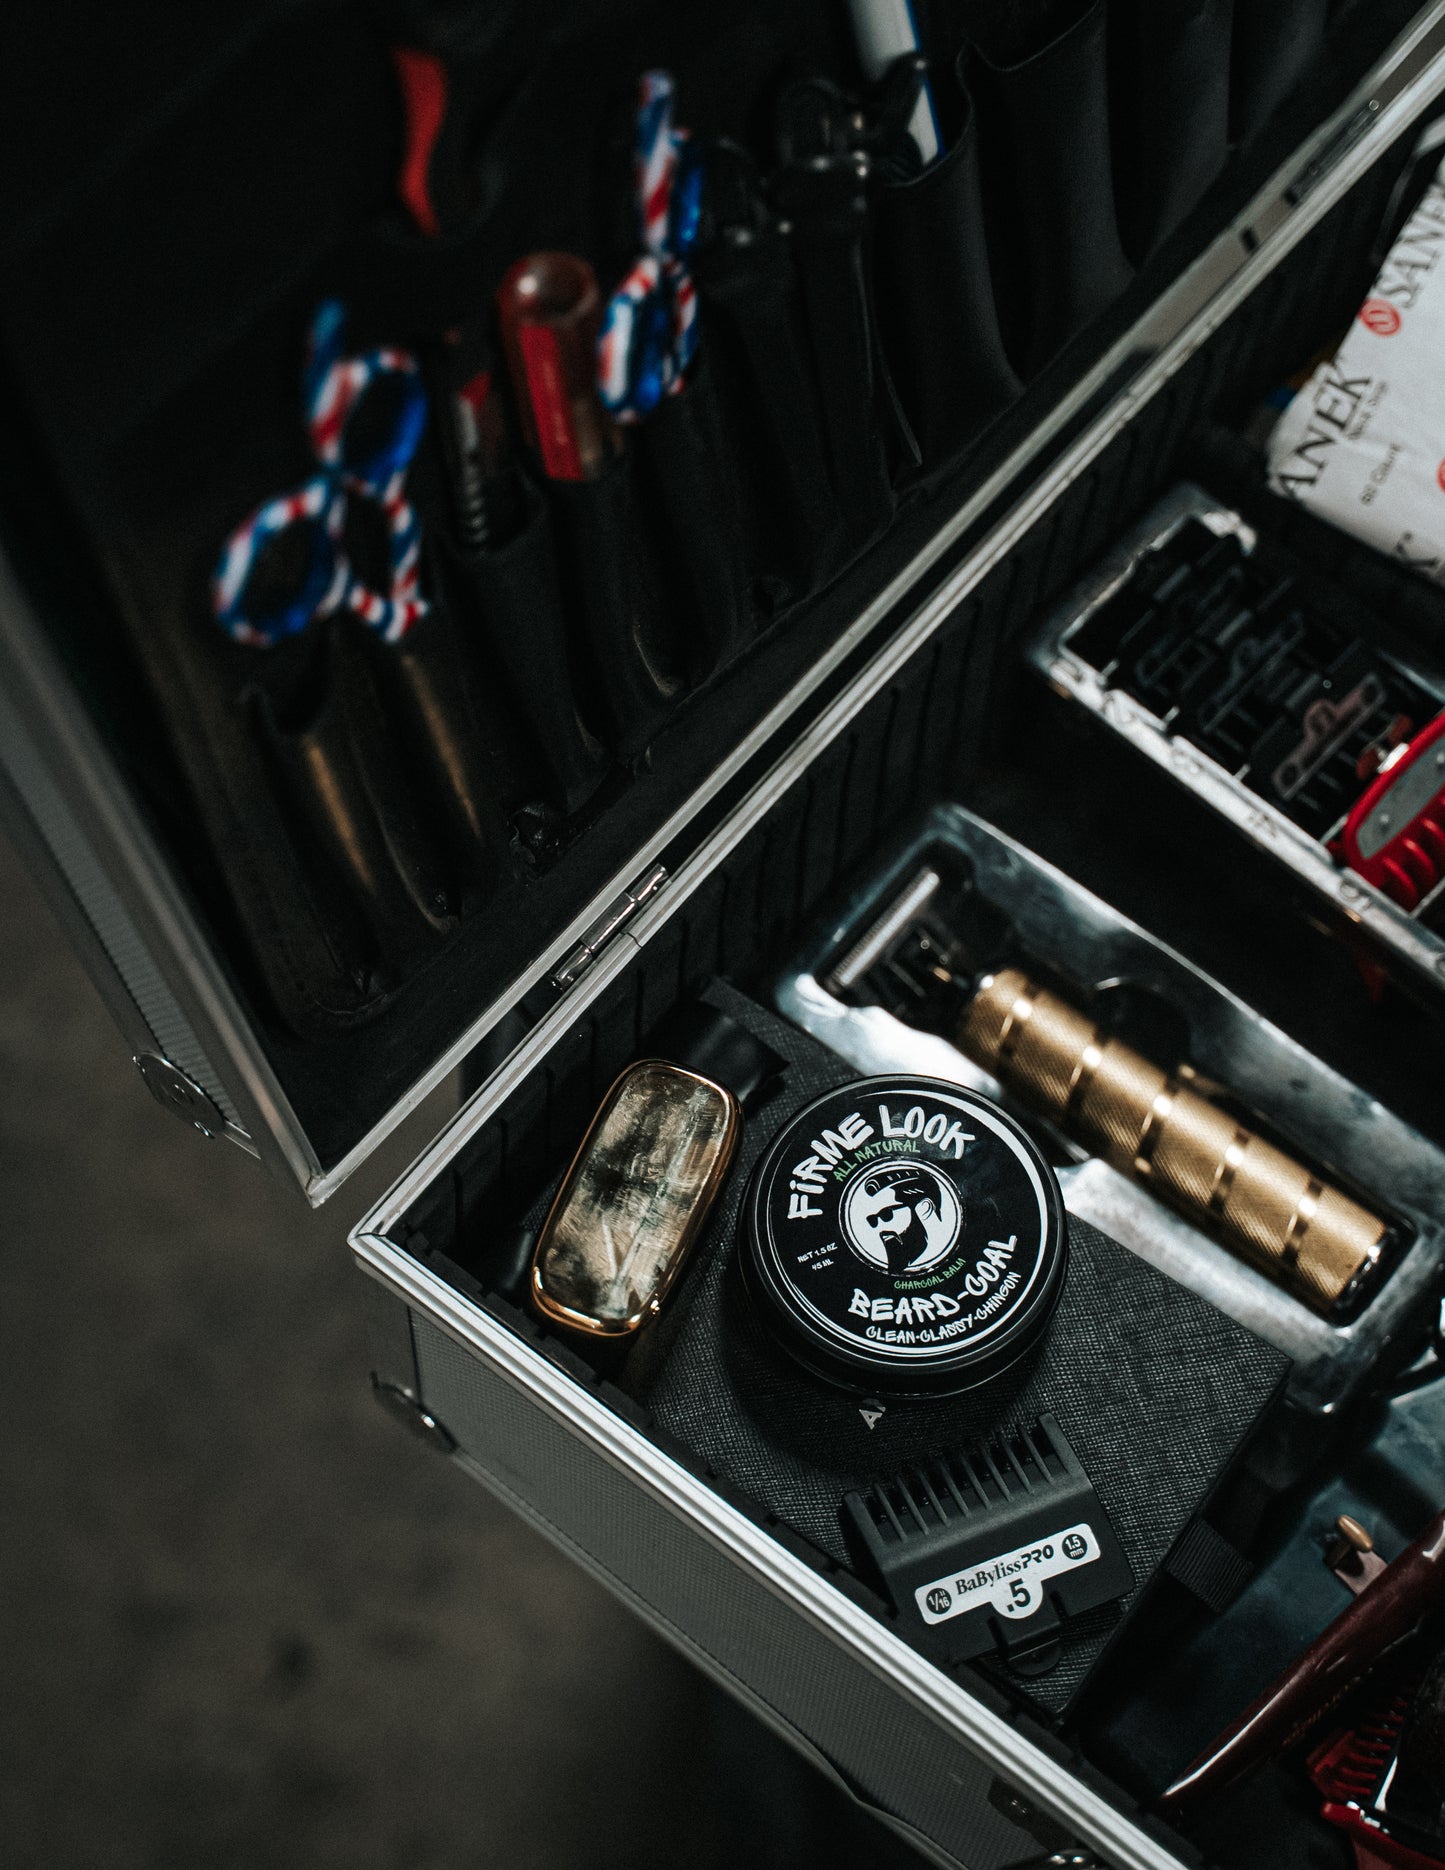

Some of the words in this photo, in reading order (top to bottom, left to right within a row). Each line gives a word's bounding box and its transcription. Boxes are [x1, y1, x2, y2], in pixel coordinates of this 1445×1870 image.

[879, 1104, 976, 1160] LOOK
[833, 1160, 858, 1182] ALL
[854, 1139, 921, 1164] NATURAL
[797, 1250, 813, 1263] NET
[826, 1242, 838, 1252] OZ
[811, 1262, 823, 1271] 45
[822, 1258, 834, 1267] ML
[893, 1277, 944, 1290] CHARCOAL
[943, 1257, 967, 1280] BALM
[1065, 1535, 1081, 1550] 1.5
[1069, 1547, 1084, 1558] mm
[1006, 1578, 1031, 1613] .5
